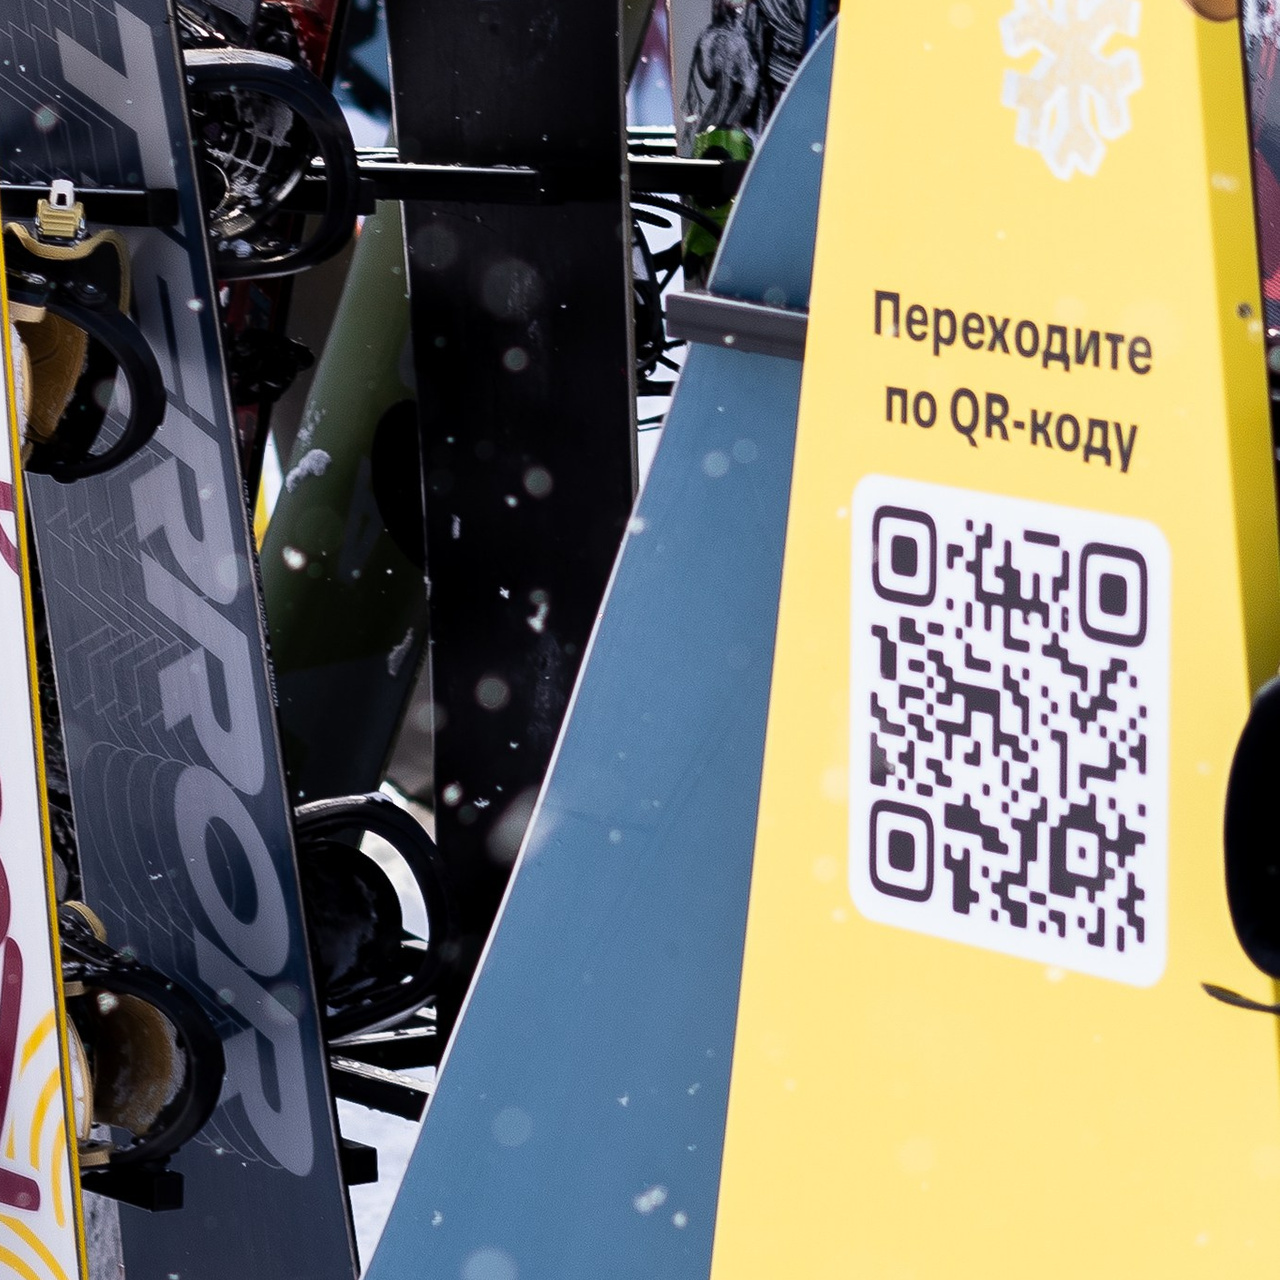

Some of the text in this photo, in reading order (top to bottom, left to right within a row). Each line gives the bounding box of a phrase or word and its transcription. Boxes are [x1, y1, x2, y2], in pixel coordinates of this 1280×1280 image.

[874, 289, 1153, 375] Переходите
[885, 385, 1138, 474] по QR-коду
[57, 2, 312, 1176] TERROR
